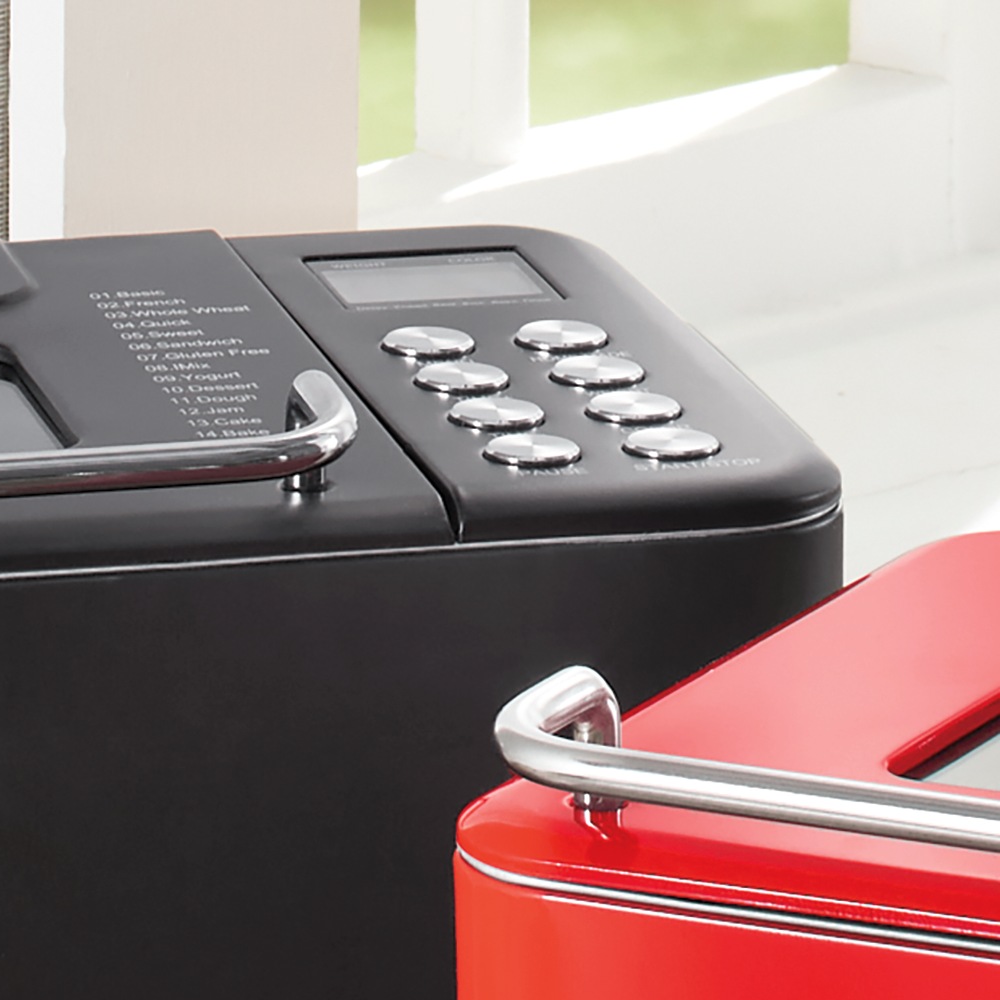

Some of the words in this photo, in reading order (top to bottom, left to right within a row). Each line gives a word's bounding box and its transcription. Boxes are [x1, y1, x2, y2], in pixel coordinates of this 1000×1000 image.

[89, 289, 165, 300] 01.Basic
[96, 298, 186, 310] 02.French
[104, 309, 188, 319] 03.Whole
[191, 306, 250, 315] Wheat
[112, 319, 191, 330] 04.Quick
[120, 329, 204, 340] 05.Sweet
[128, 338, 243, 351] 06.Sandwich
[228, 348, 270, 357] Free
[152, 371, 242, 383] 09.Yogurt
